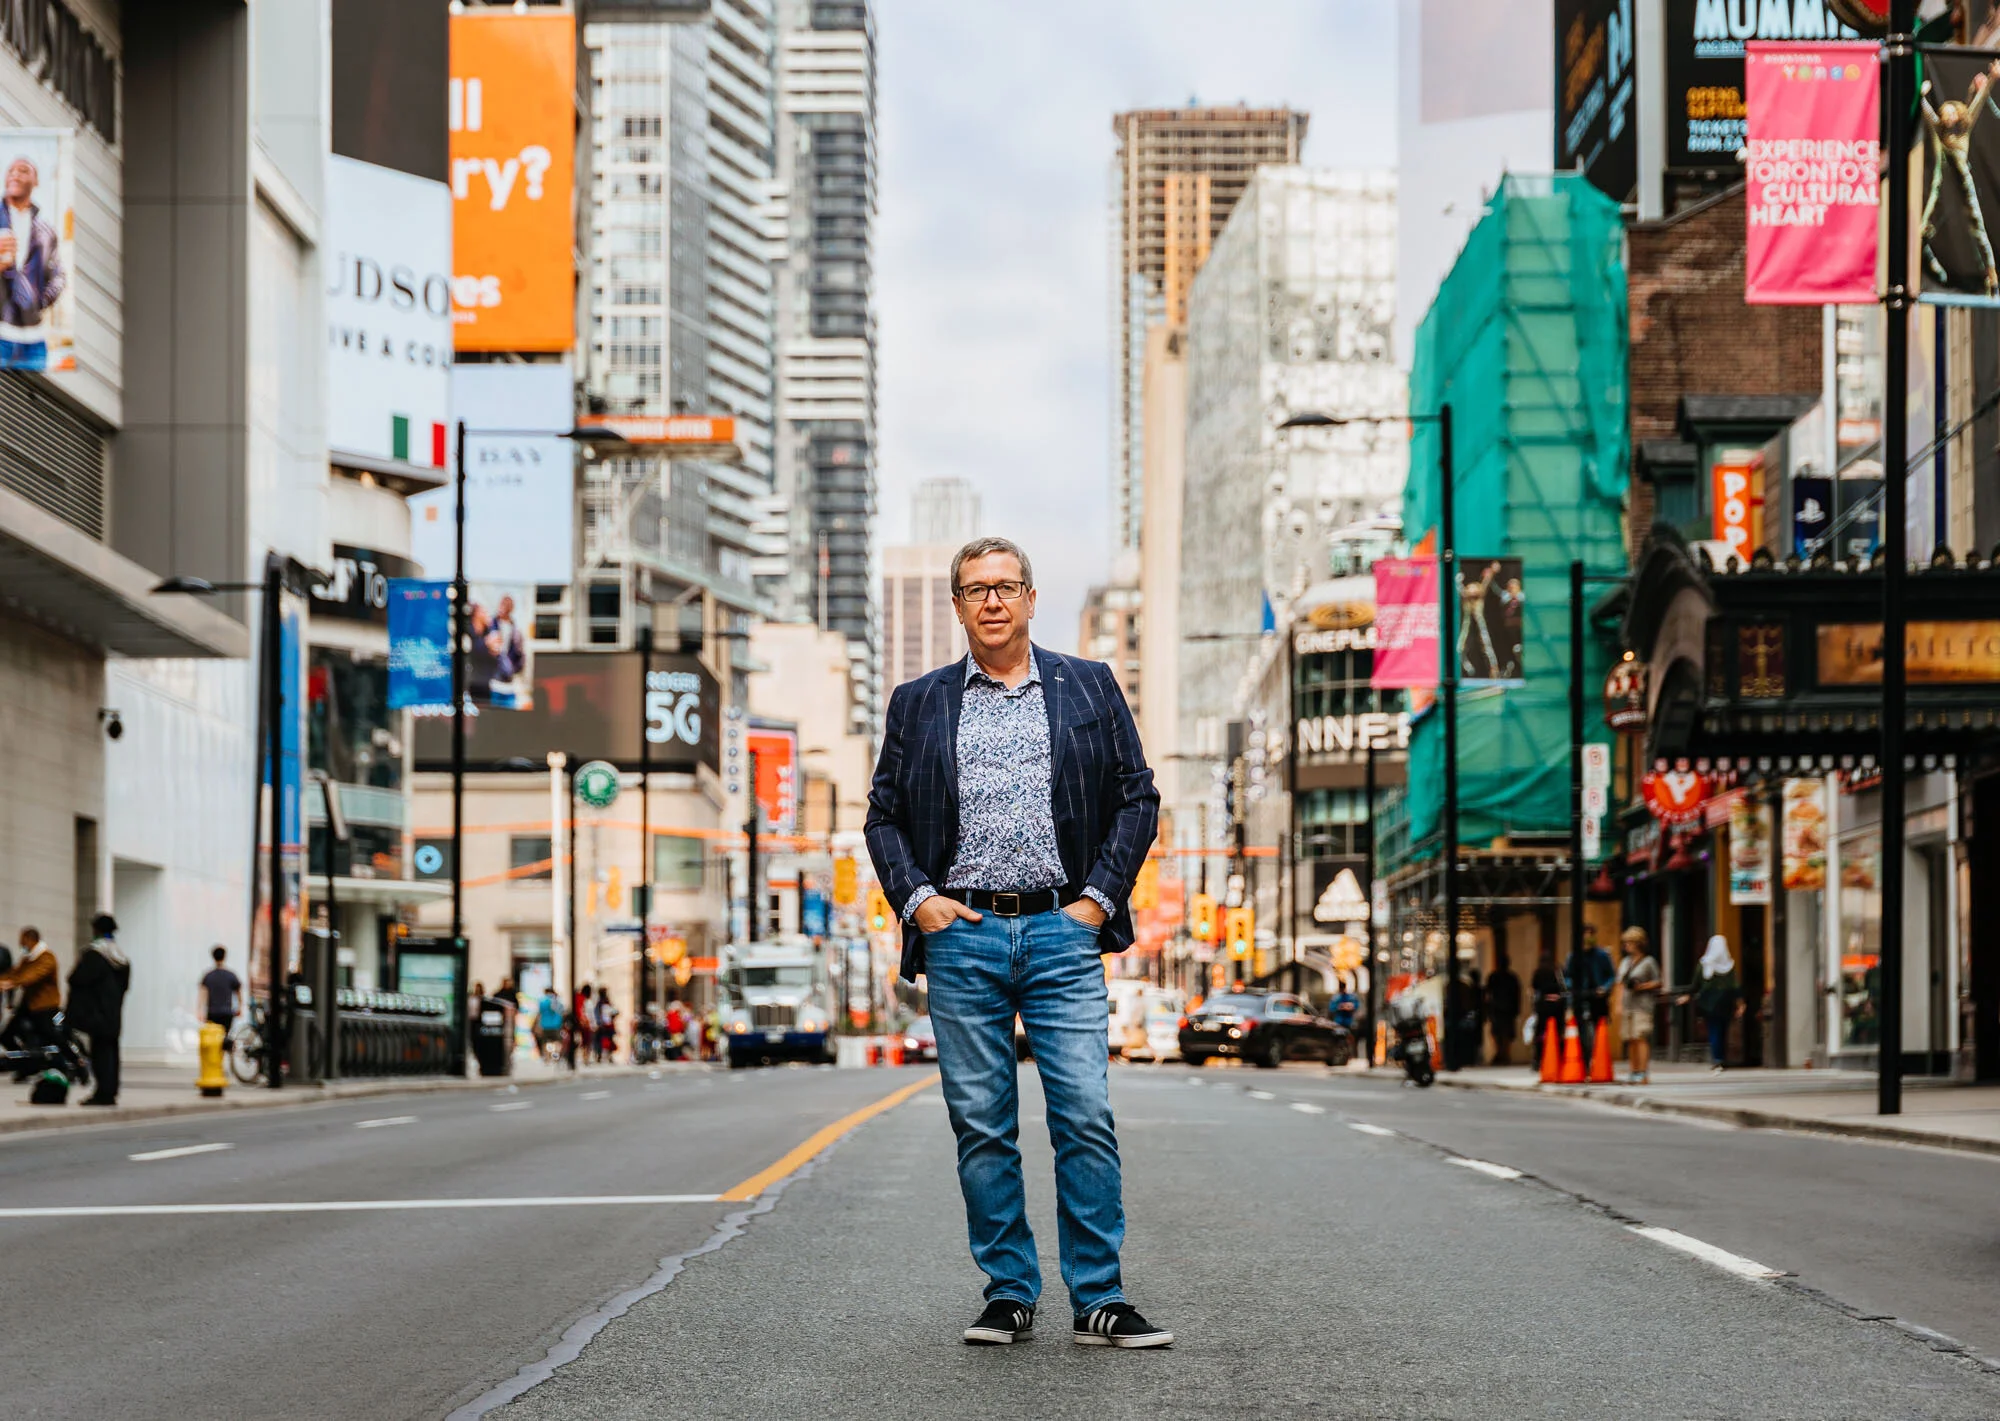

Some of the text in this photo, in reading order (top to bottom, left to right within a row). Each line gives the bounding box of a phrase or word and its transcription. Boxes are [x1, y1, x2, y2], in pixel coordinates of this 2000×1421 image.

[1747, 139, 1881, 162] EXPERIENCE
[1746, 160, 1877, 184] TORONTO'S
[1762, 182, 1880, 206] CULTURAL
[1750, 204, 1829, 227] HEART
[646, 691, 701, 746] 5G
